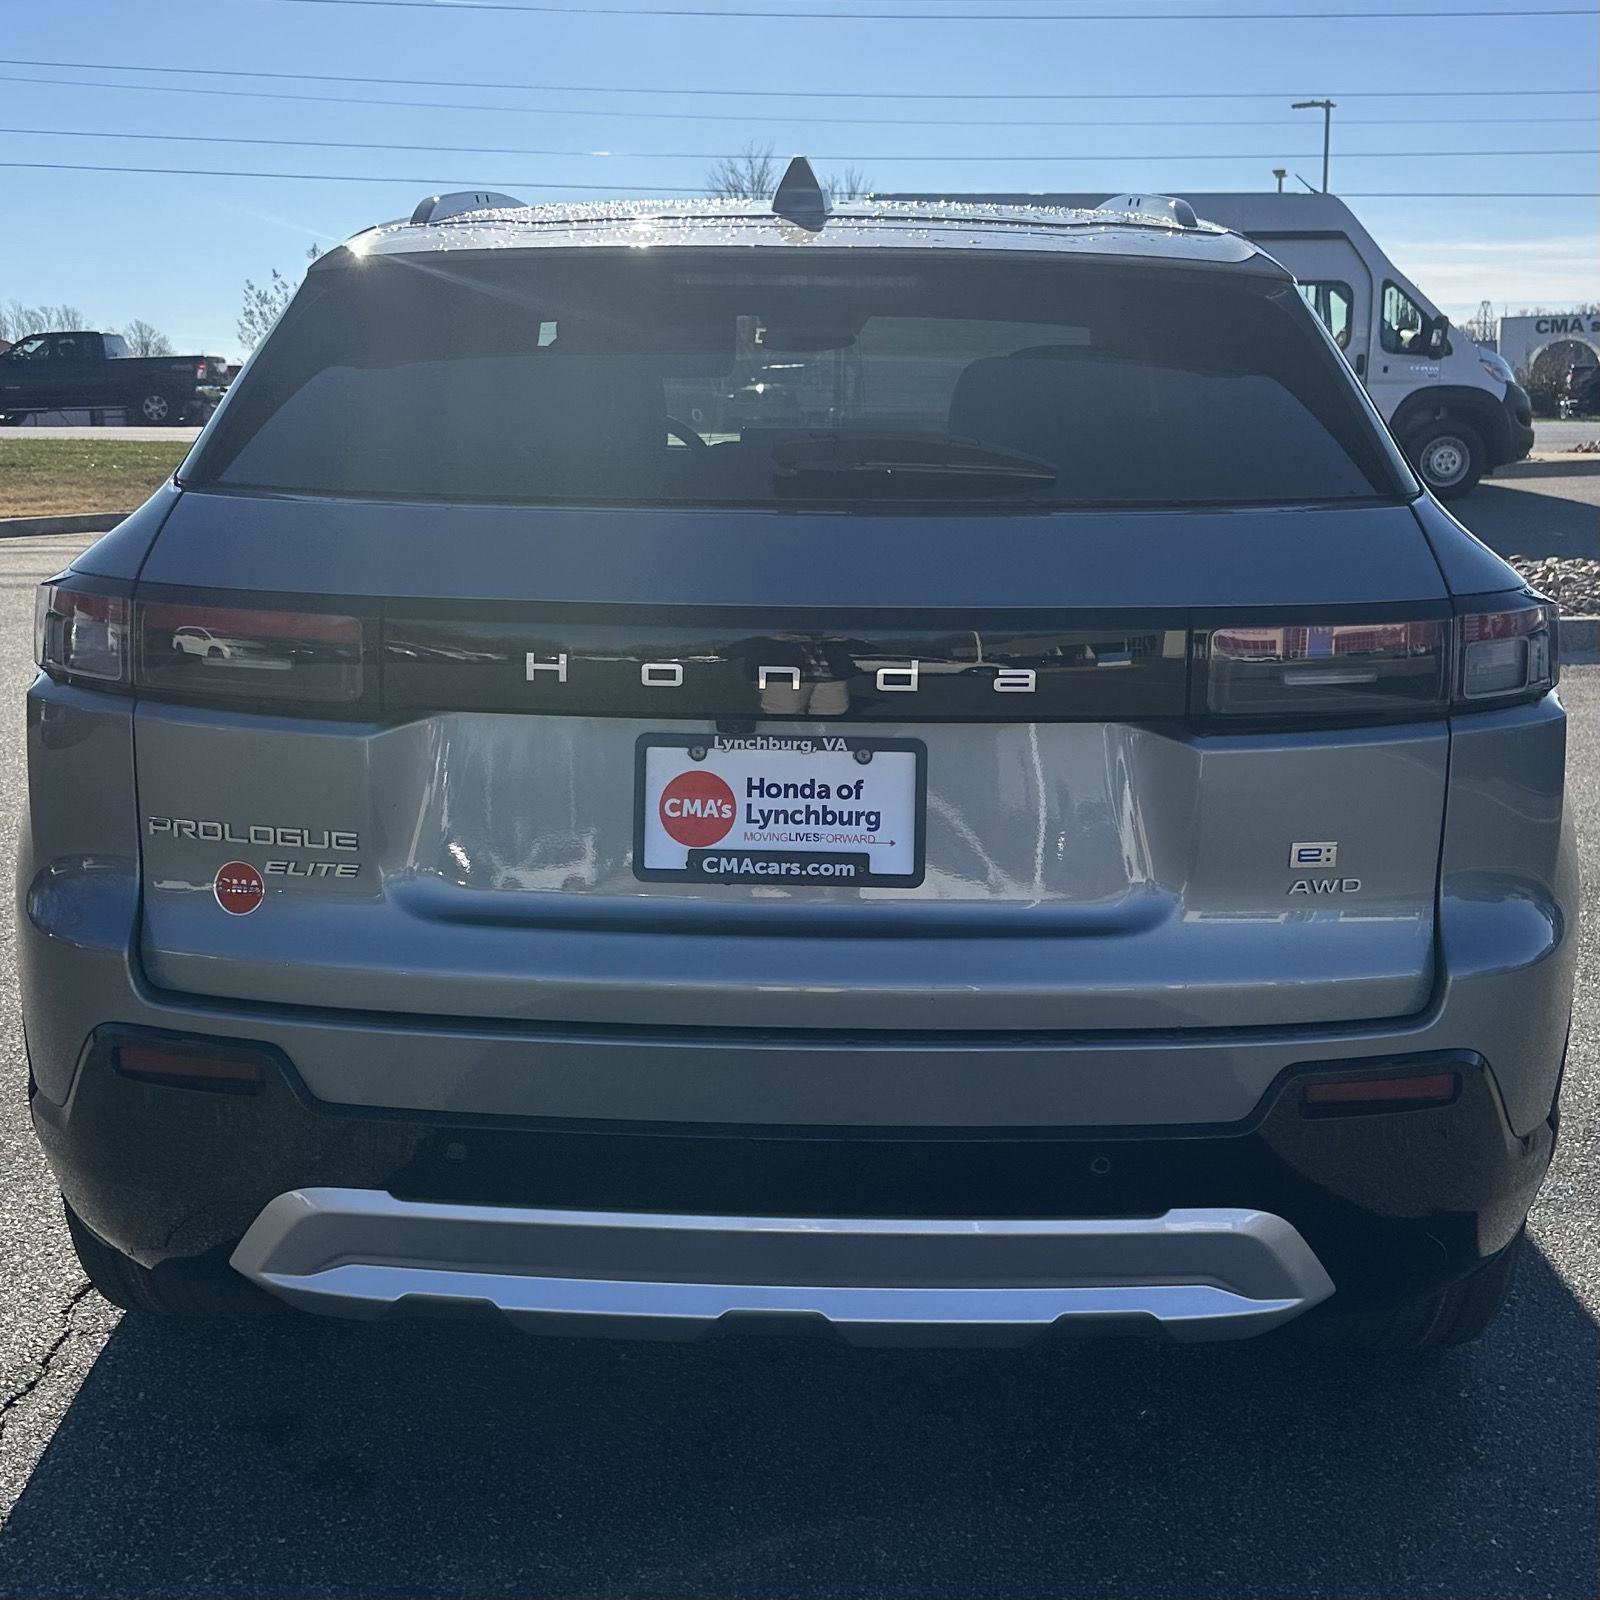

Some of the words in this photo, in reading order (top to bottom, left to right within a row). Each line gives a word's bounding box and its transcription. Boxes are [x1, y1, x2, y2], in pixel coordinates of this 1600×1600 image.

[1535, 314, 1600, 334] CMA's
[713, 735, 817, 754] Lynchburg,
[822, 737, 848, 752] VA
[746, 777, 831, 800] Honda
[836, 779, 864, 800] of
[663, 798, 733, 818] CMA's
[745, 803, 881, 831] Lynchburg
[149, 816, 359, 851] PROLOGUE
[264, 860, 360, 878] ELITE
[702, 856, 856, 877] CMAcars.com
[1288, 878, 1362, 895] AWD
